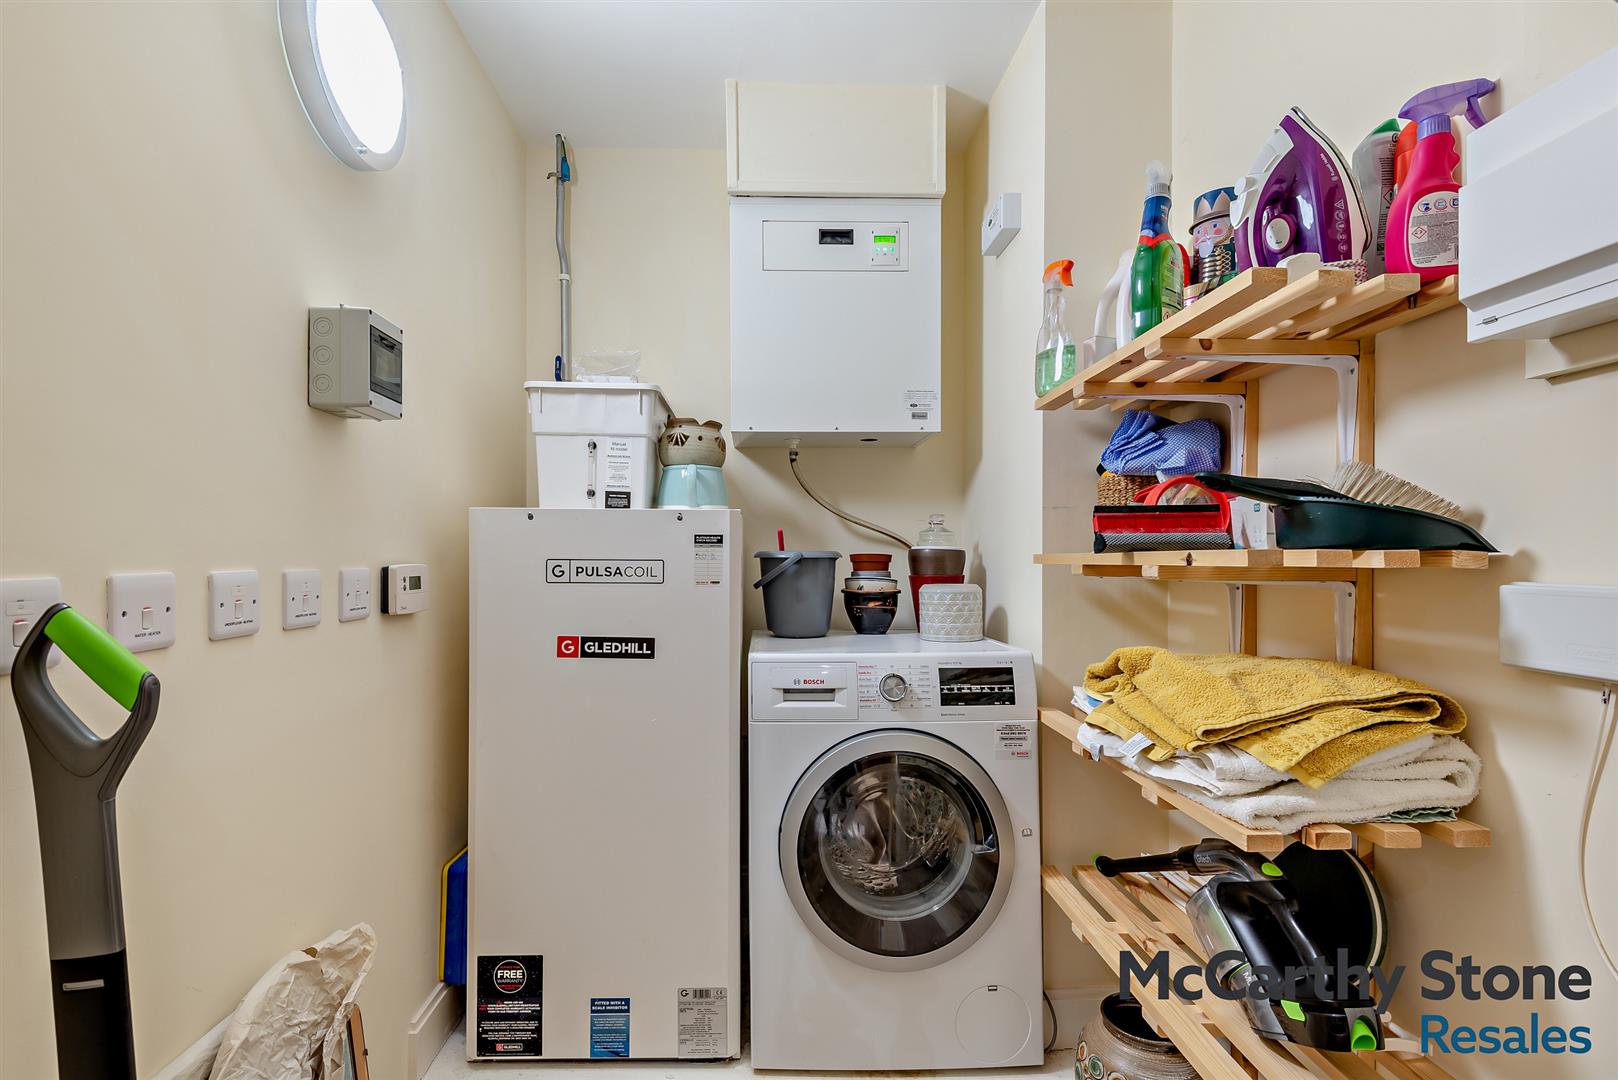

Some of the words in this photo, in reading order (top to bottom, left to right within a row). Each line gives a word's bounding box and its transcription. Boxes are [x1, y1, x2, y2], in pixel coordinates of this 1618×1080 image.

[552, 564, 565, 578] G
[576, 566, 658, 577] PULSACOIL
[561, 640, 575, 654] G
[584, 642, 651, 654] GLEDHILL
[497, 970, 523, 978] FREE
